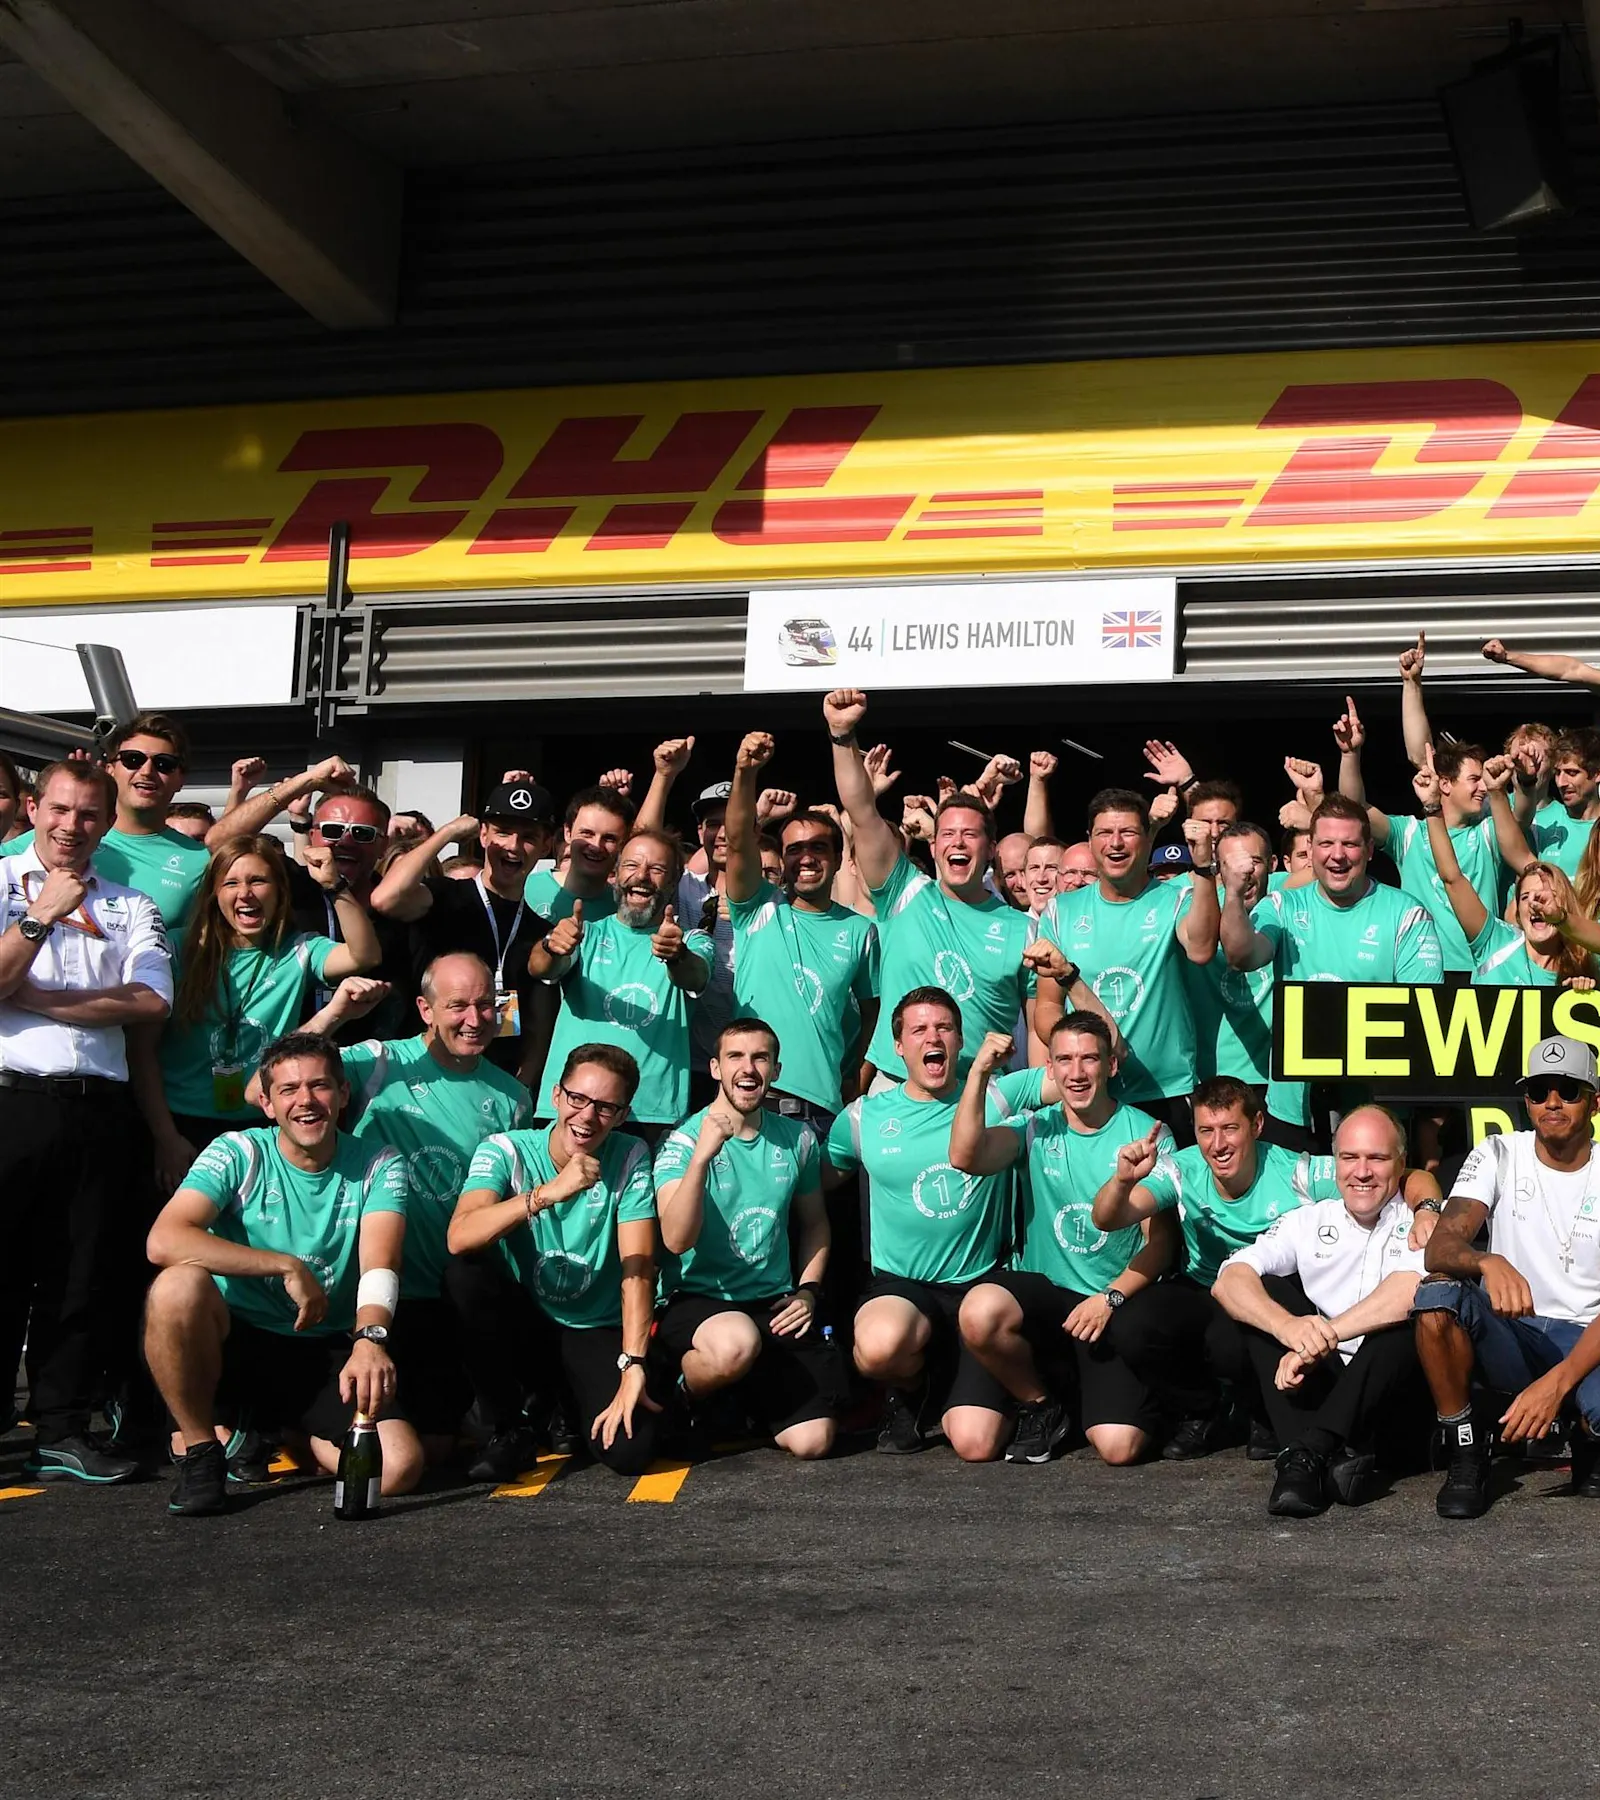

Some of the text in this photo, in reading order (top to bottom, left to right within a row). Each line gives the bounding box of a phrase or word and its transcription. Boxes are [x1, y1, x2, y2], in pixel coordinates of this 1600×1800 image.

[260, 405, 914, 563] DHL
[848, 619, 1075, 652] 44 LEWIS HAMILTON
[1109, 977, 1123, 1006] 1
[916, 1169, 927, 1183] GP
[932, 1174, 950, 1206] 1
[937, 1208, 958, 1219] 2016
[1074, 1214, 1086, 1242] 1
[748, 1217, 763, 1249] 1
[1069, 1245, 1088, 1254] 2016
